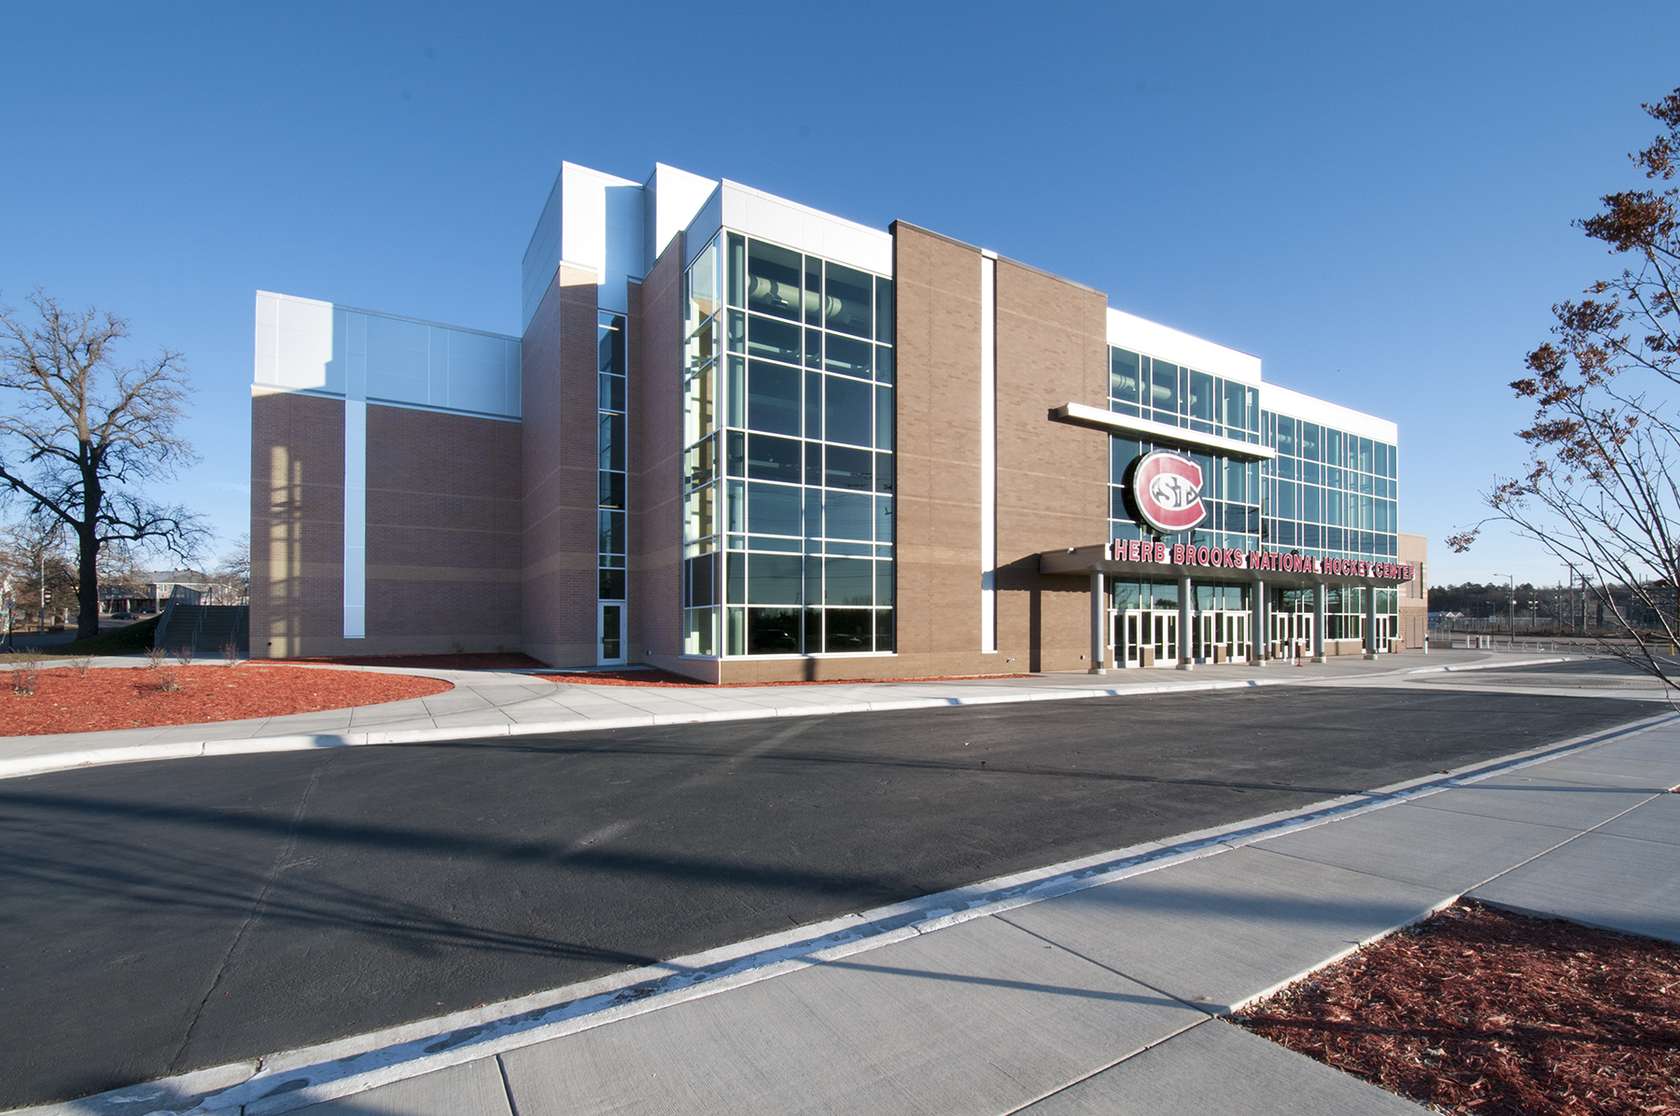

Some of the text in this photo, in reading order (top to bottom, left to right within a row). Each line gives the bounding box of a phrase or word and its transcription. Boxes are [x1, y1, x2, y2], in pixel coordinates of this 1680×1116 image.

[1114, 538, 1415, 580] HERB BROOKS NATIONAL HOCKEY CENTER
